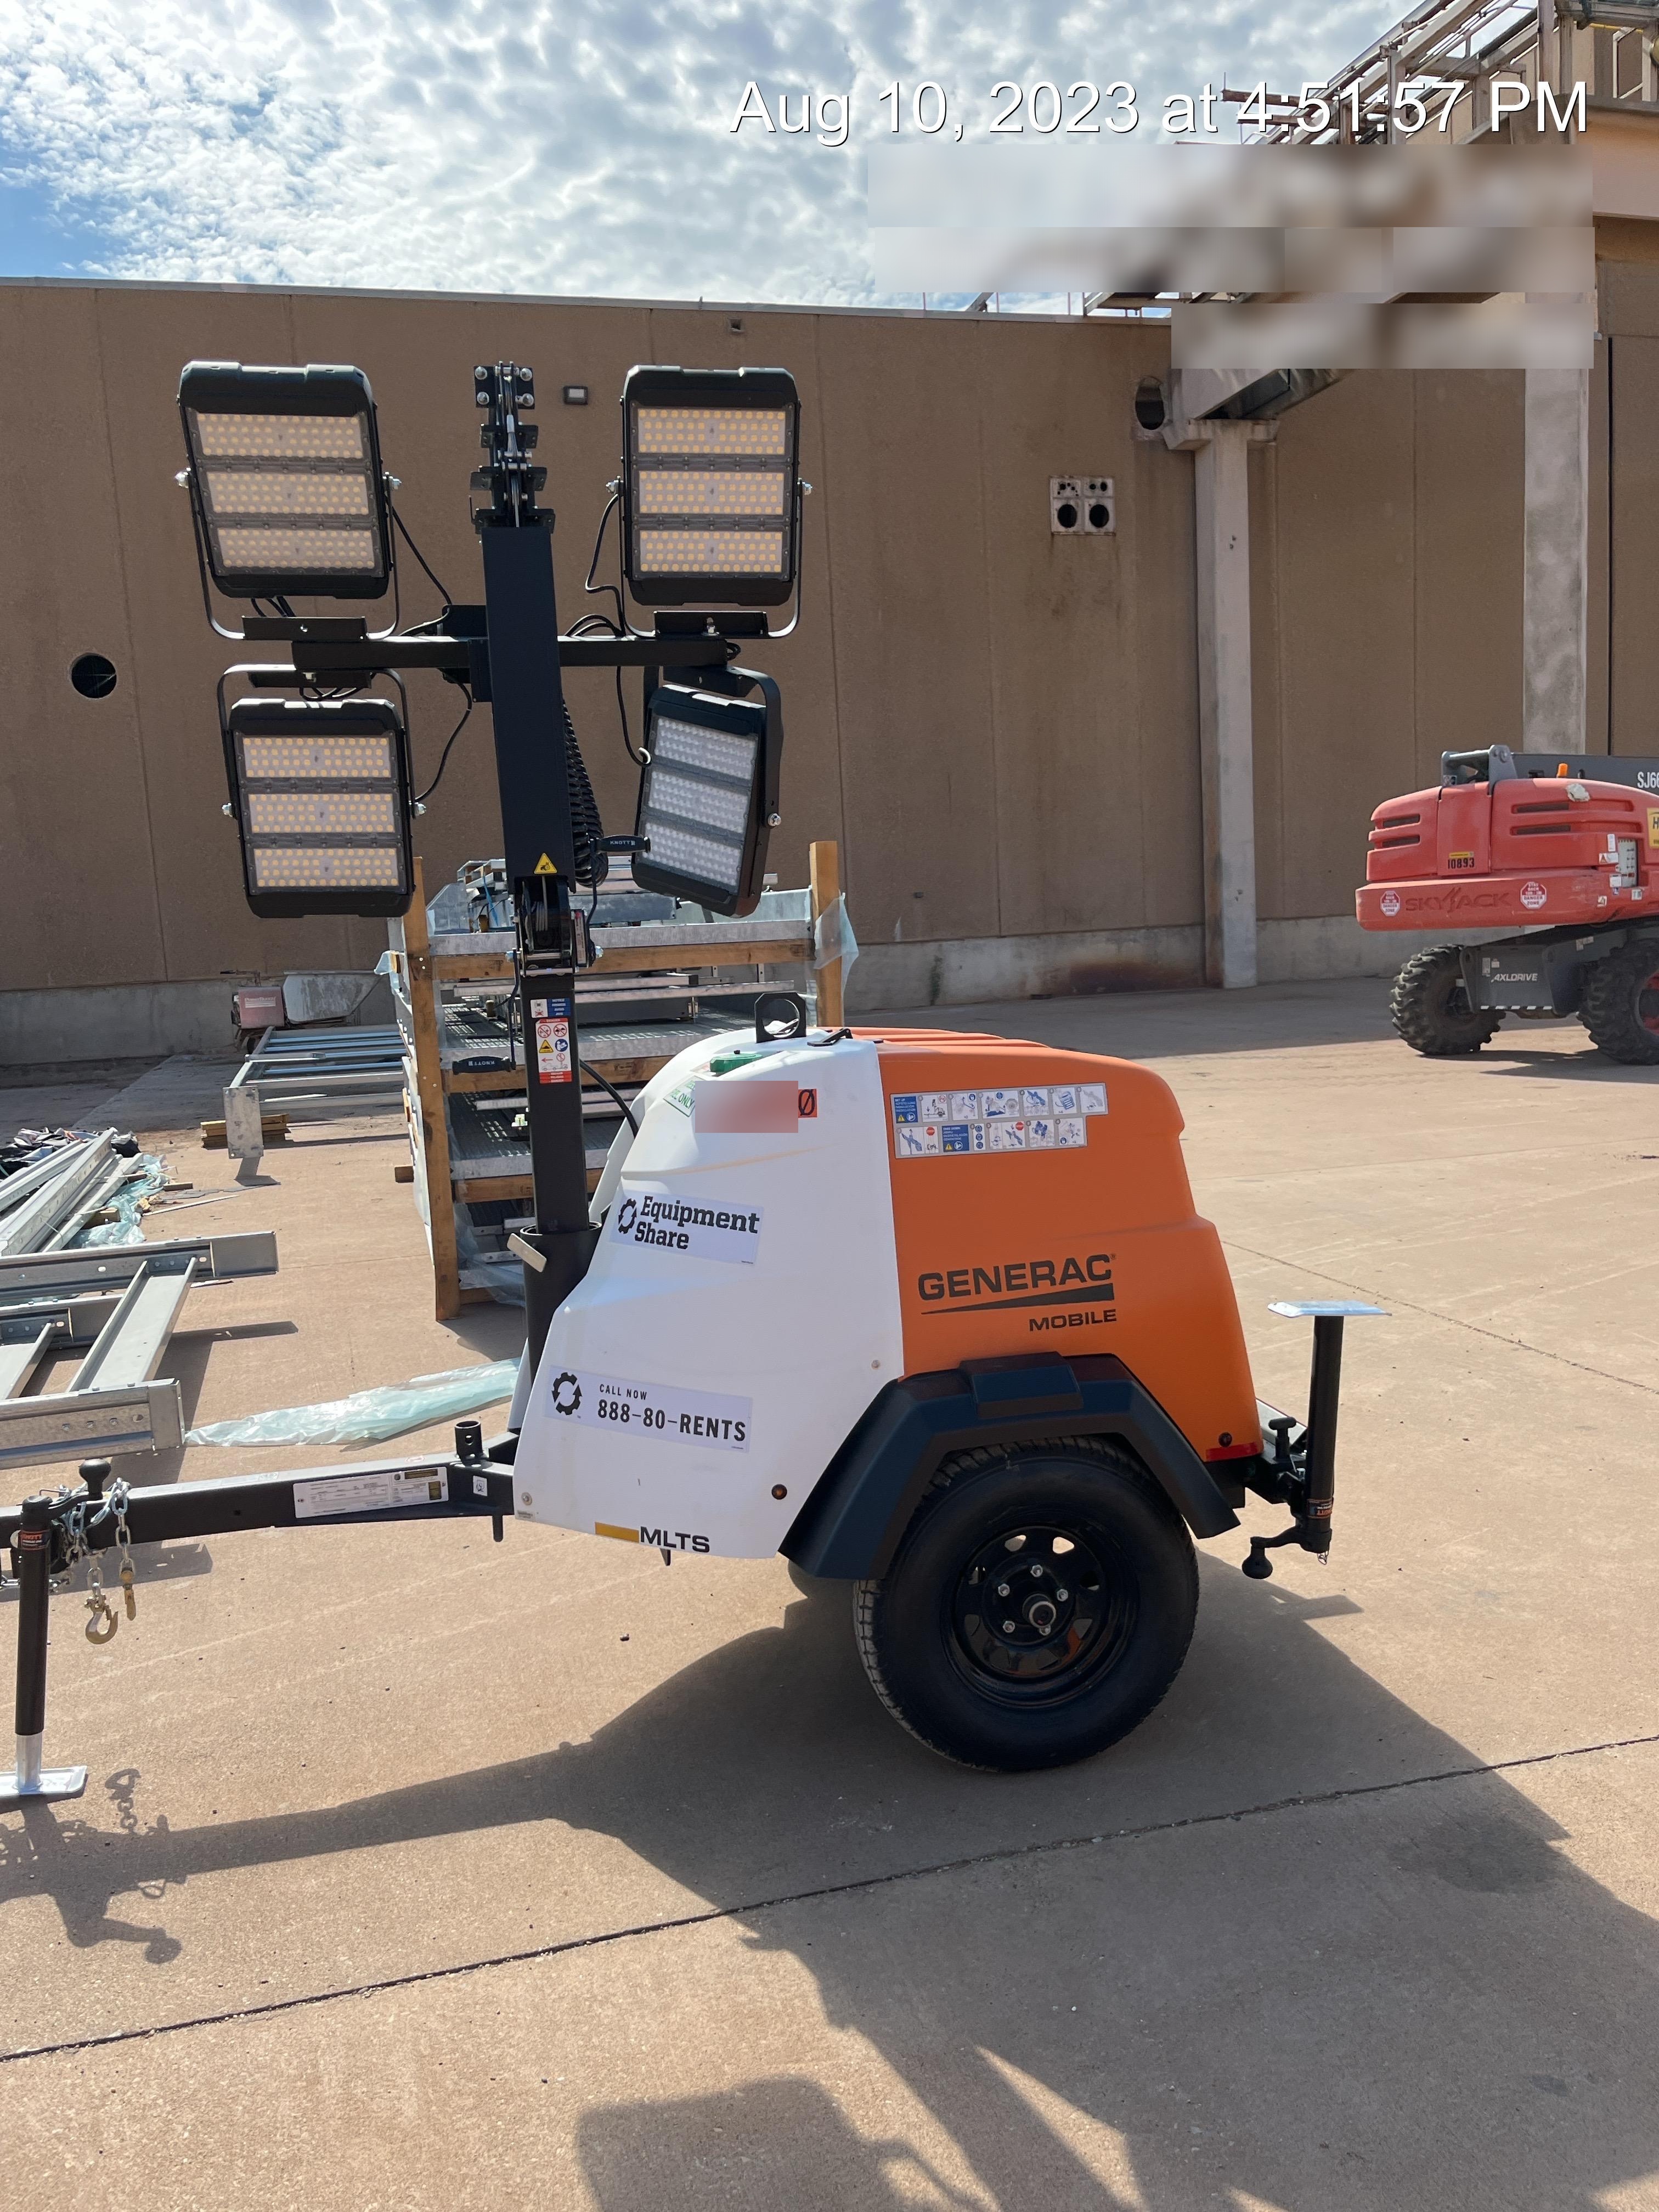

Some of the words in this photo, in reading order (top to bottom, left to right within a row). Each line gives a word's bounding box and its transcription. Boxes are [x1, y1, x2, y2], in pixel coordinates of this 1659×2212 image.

[1448, 857, 1475, 870] 10893
[678, 1093, 695, 1109] ONLY
[640, 1195, 760, 1234] Equipment
[635, 1221, 689, 1249] Share
[918, 1254, 1111, 1301] GENERAC
[1029, 1309, 1117, 1331] MOBILE
[600, 1384, 622, 1396] CALL
[627, 1389, 647, 1400] NOW
[598, 1400, 746, 1442] 888-80-RENTS
[640, 1526, 710, 1553] MLTS
